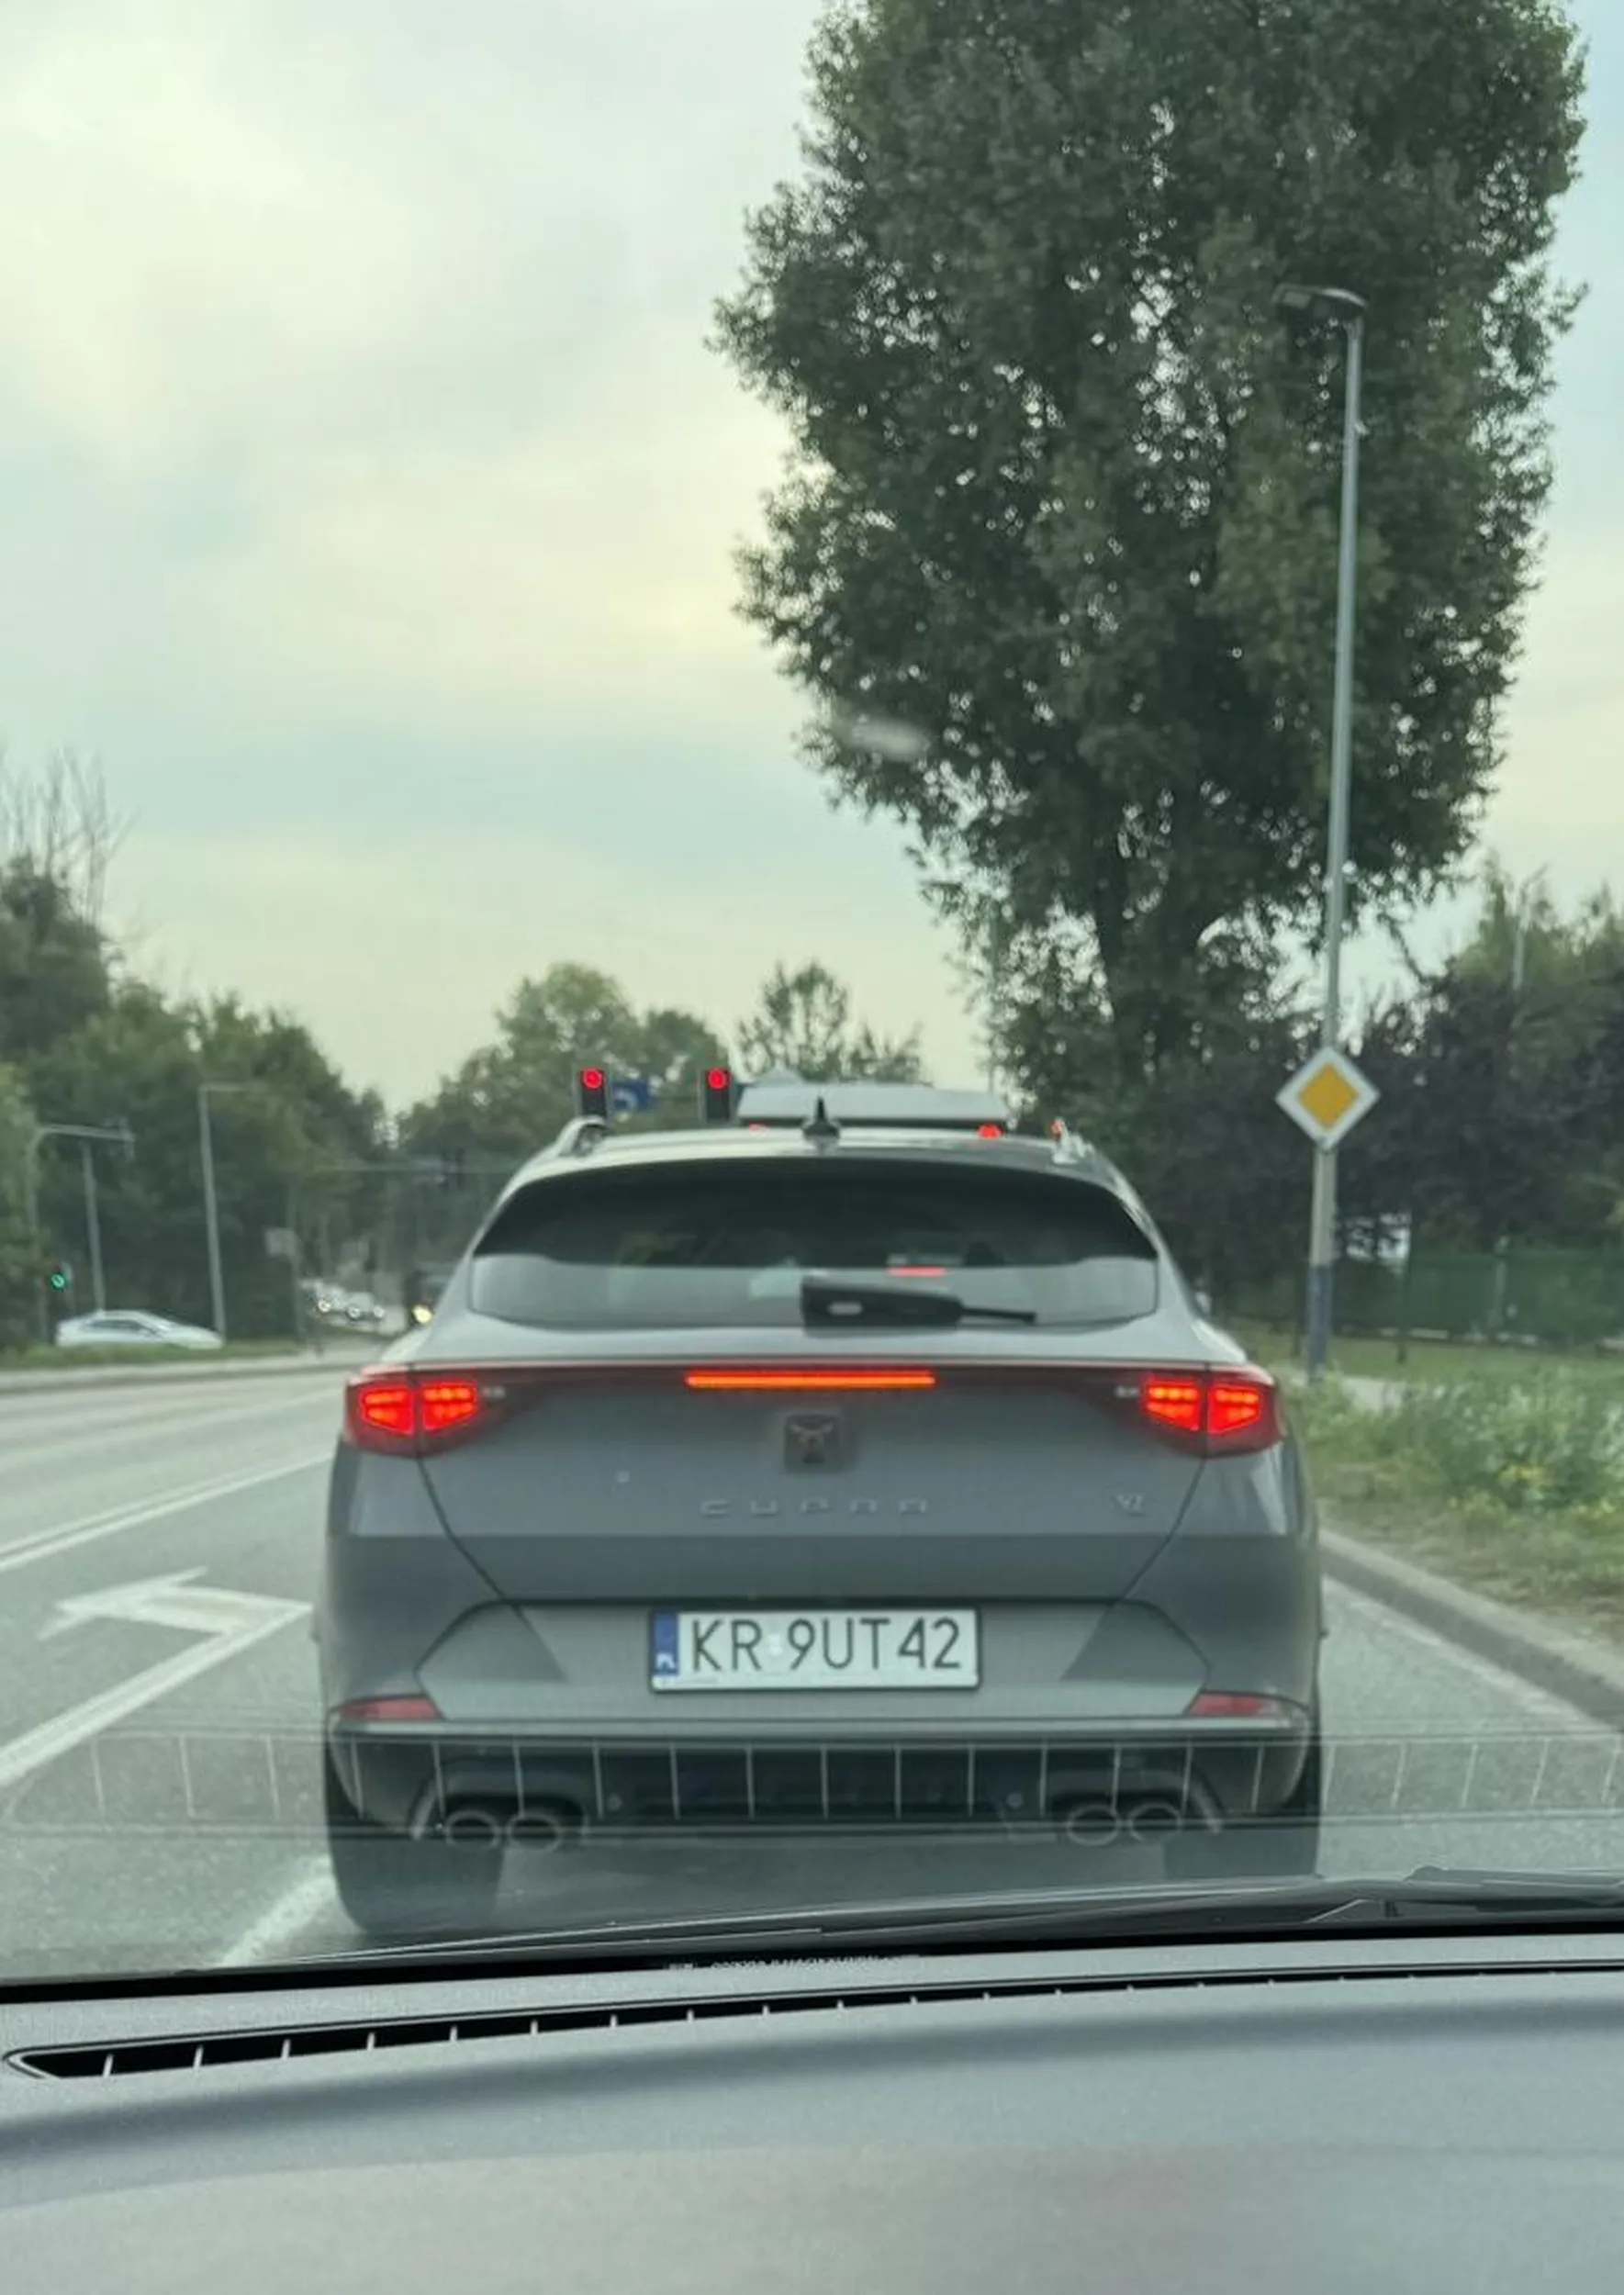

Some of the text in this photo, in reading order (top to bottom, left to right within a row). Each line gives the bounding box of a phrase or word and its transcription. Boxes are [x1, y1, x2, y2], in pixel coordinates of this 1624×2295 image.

[700, 1496, 930, 1516] CUPRA
[691, 1617, 961, 1672] KR 9UT42
